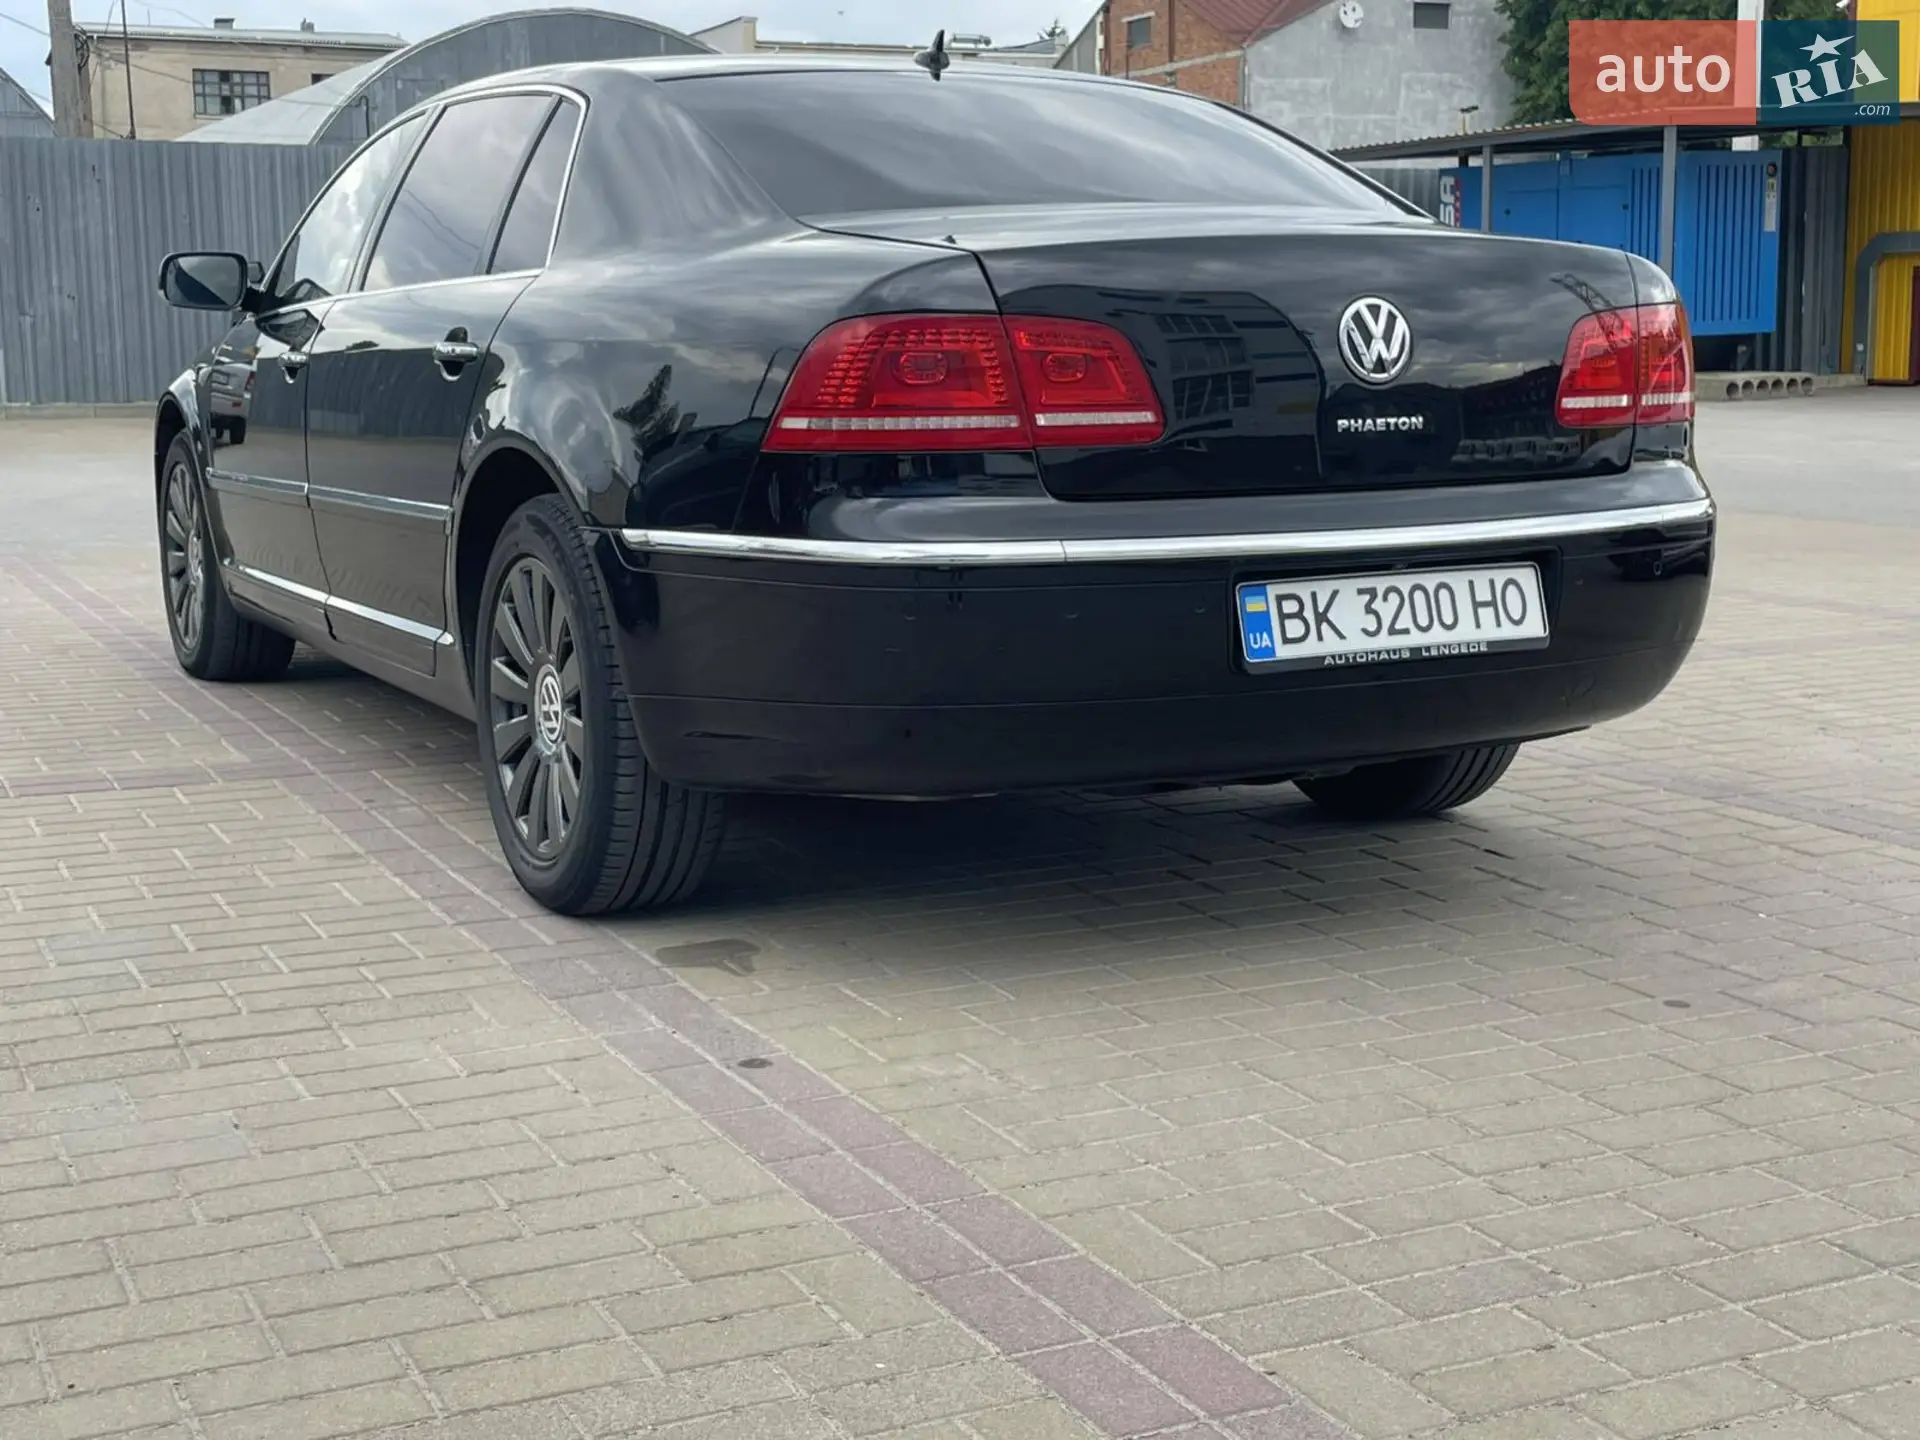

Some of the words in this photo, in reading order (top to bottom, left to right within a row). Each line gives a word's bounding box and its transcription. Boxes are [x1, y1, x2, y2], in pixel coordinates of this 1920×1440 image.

[1340, 298, 1410, 382] VW
[1337, 416, 1424, 433] PHAETON
[1275, 588, 1347, 645] BK
[1356, 581, 1459, 637] 3200
[1467, 577, 1527, 629] HO
[1249, 632, 1272, 649] UA
[1324, 648, 1410, 665] AUTOHAUS
[1421, 641, 1488, 657] LENGEDE
